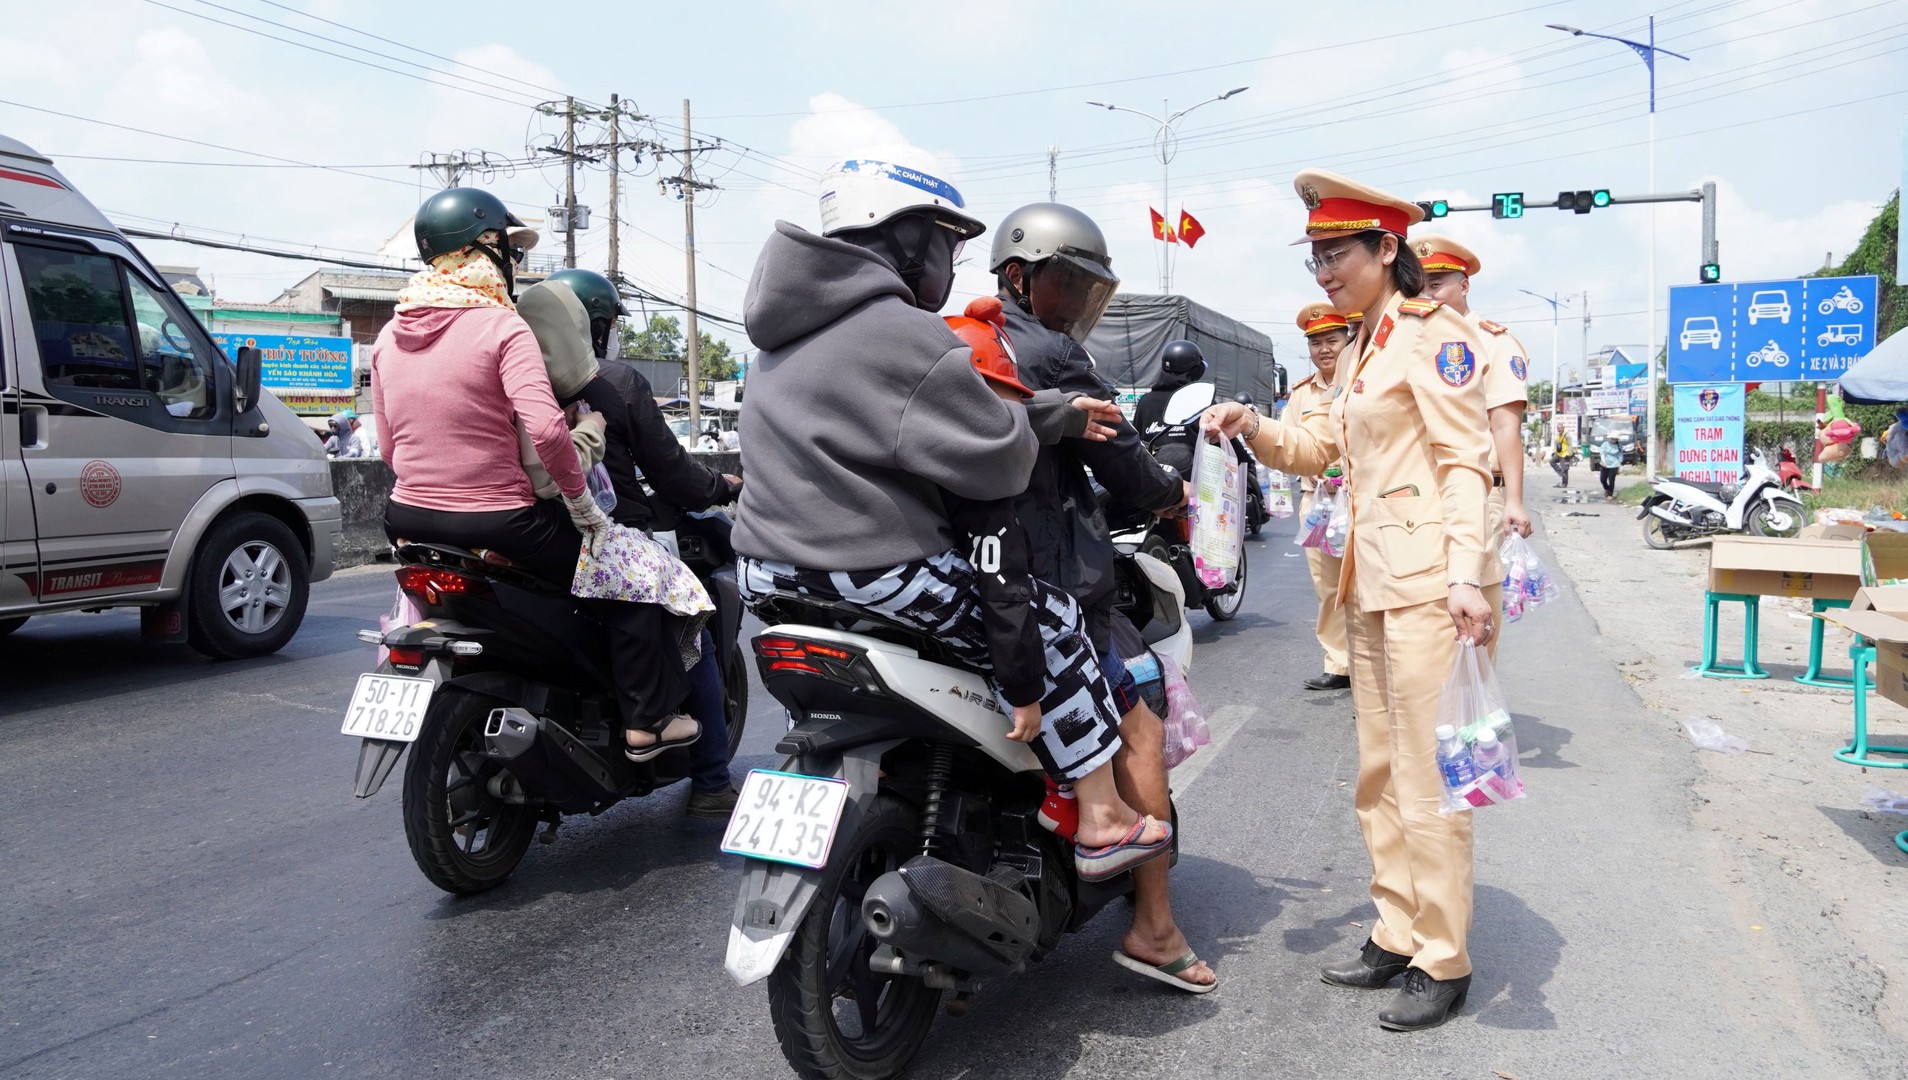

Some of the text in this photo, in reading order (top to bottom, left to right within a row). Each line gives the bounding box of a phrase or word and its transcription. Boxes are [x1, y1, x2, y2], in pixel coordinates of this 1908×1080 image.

[1495, 194, 1521, 218] 76
[1810, 357, 1820, 370] XE
[1822, 357, 1827, 370] 2
[1829, 354, 1839, 369] VÀ
[1840, 357, 1846, 369] 3
[95, 395, 151, 408] TRANSIT
[1695, 428, 1723, 443] TRẠM
[1680, 446, 1739, 462] DỪNG CHÂN
[1714, 468, 1738, 482] TÌNH
[51, 572, 103, 591] TRANSIT
[365, 679, 420, 708] 50-Y1
[350, 706, 417, 736] 718.26
[810, 712, 842, 720] HONDA
[730, 814, 828, 860] 241.35
